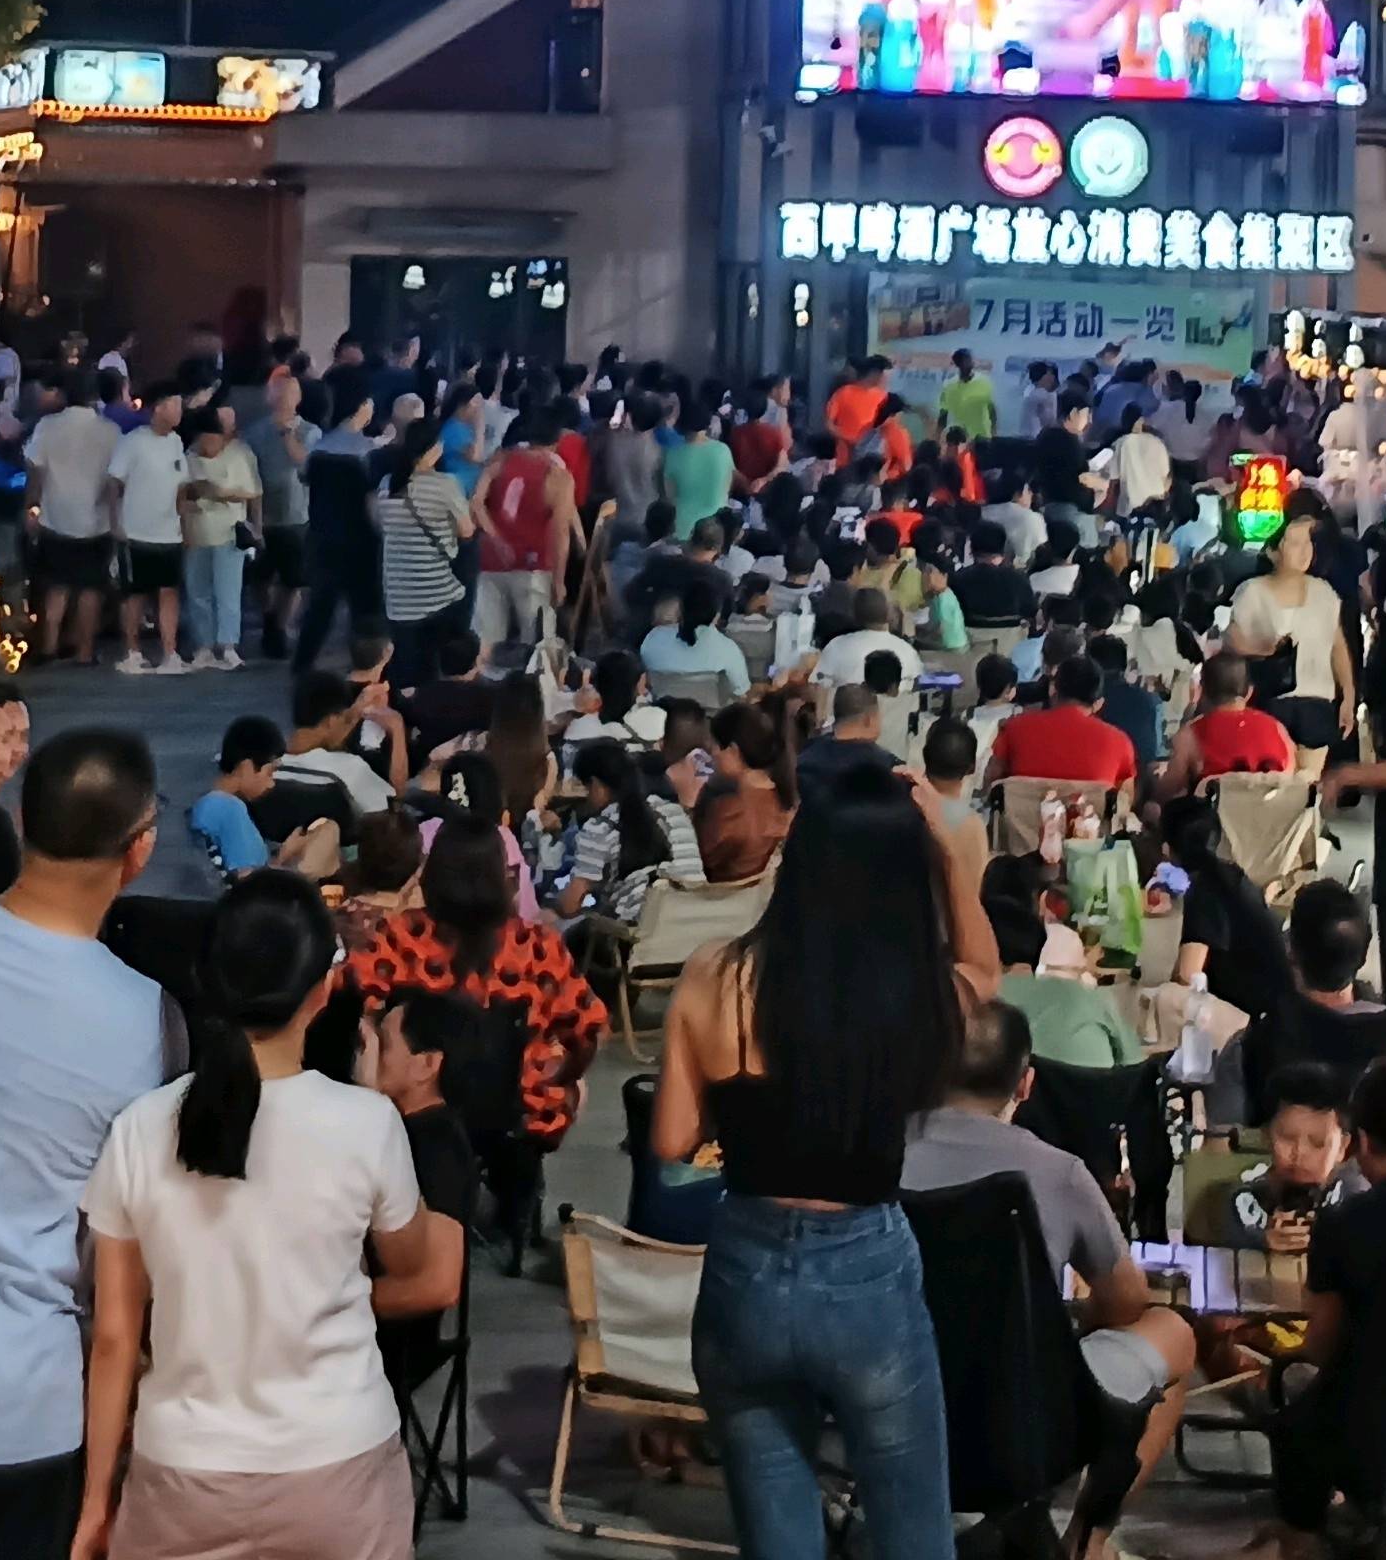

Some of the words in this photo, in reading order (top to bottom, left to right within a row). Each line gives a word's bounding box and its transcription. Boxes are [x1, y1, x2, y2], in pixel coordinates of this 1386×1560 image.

[973, 296, 1177, 342] 7月活动一览
